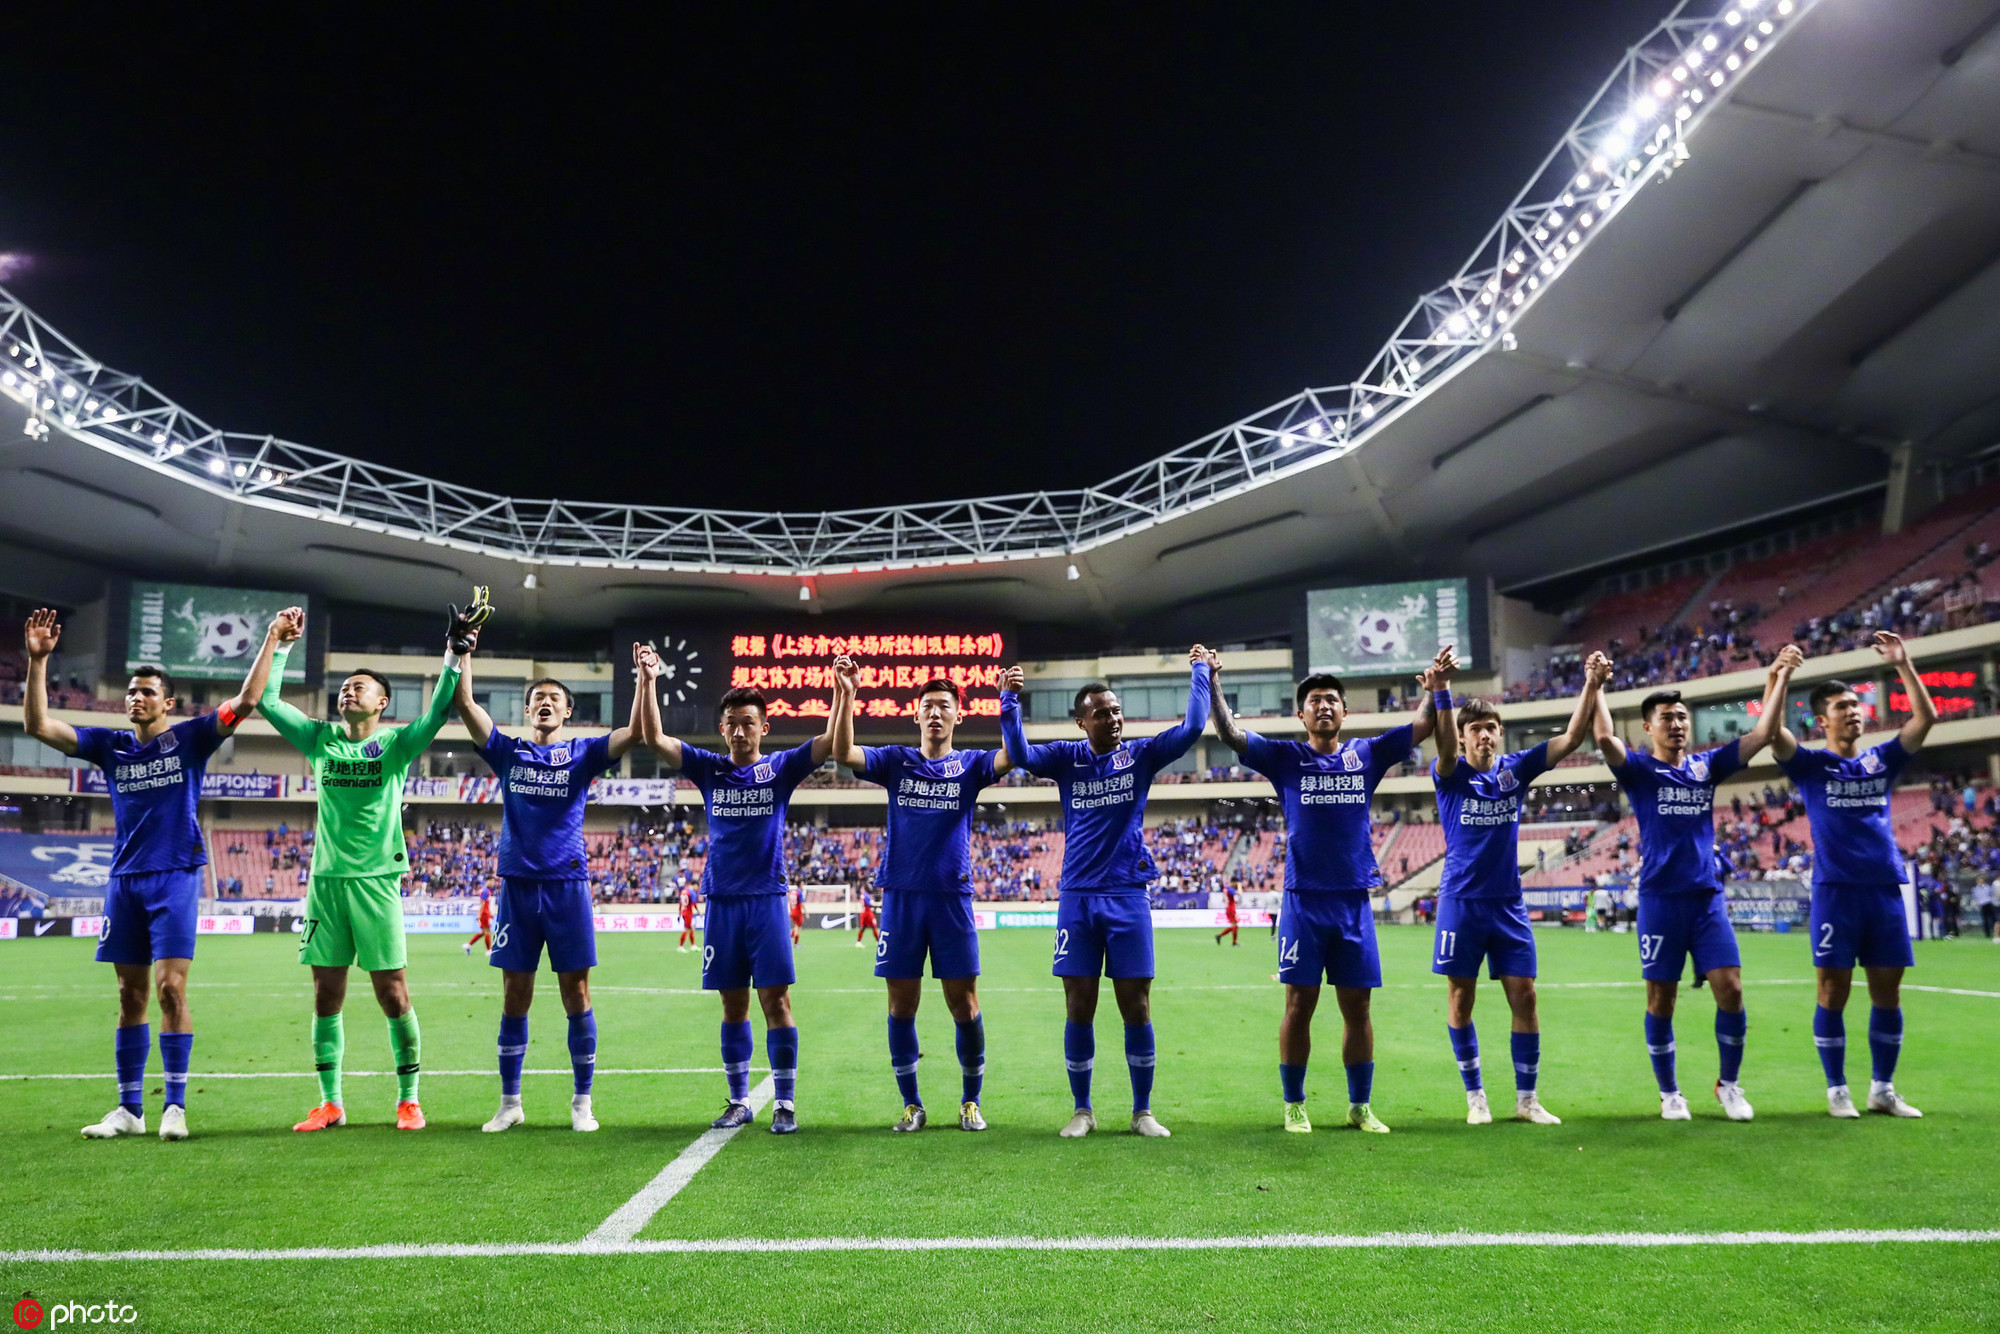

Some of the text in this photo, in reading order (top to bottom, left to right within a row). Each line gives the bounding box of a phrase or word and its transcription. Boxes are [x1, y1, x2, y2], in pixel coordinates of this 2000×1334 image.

[139, 591, 164, 661] FOOTBALL
[1436, 587, 1459, 656] HONGKO
[115, 756, 182, 780] 绿地控股
[323, 759, 382, 776] 绿地控股
[509, 765, 570, 784] 绿地控股
[117, 772, 183, 793] Greenland
[202, 774, 272, 789] MPIONS!
[322, 776, 382, 788] Greenland
[509, 782, 568, 798] Greenland
[898, 778, 961, 798] 绿地控股
[1072, 773, 1134, 796] 绿地控股
[1300, 775, 1365, 792] 绿地控股
[712, 788, 774, 804] 绿地控股
[897, 795, 959, 810] Greenland
[1071, 790, 1134, 809] Greenland
[1301, 793, 1366, 805] Greenland
[712, 804, 773, 816] Greenland
[1440, 930, 1456, 957] 11
[1820, 923, 1834, 948] 2
[1280, 936, 1299, 964] 14
[1641, 934, 1664, 960] 37
